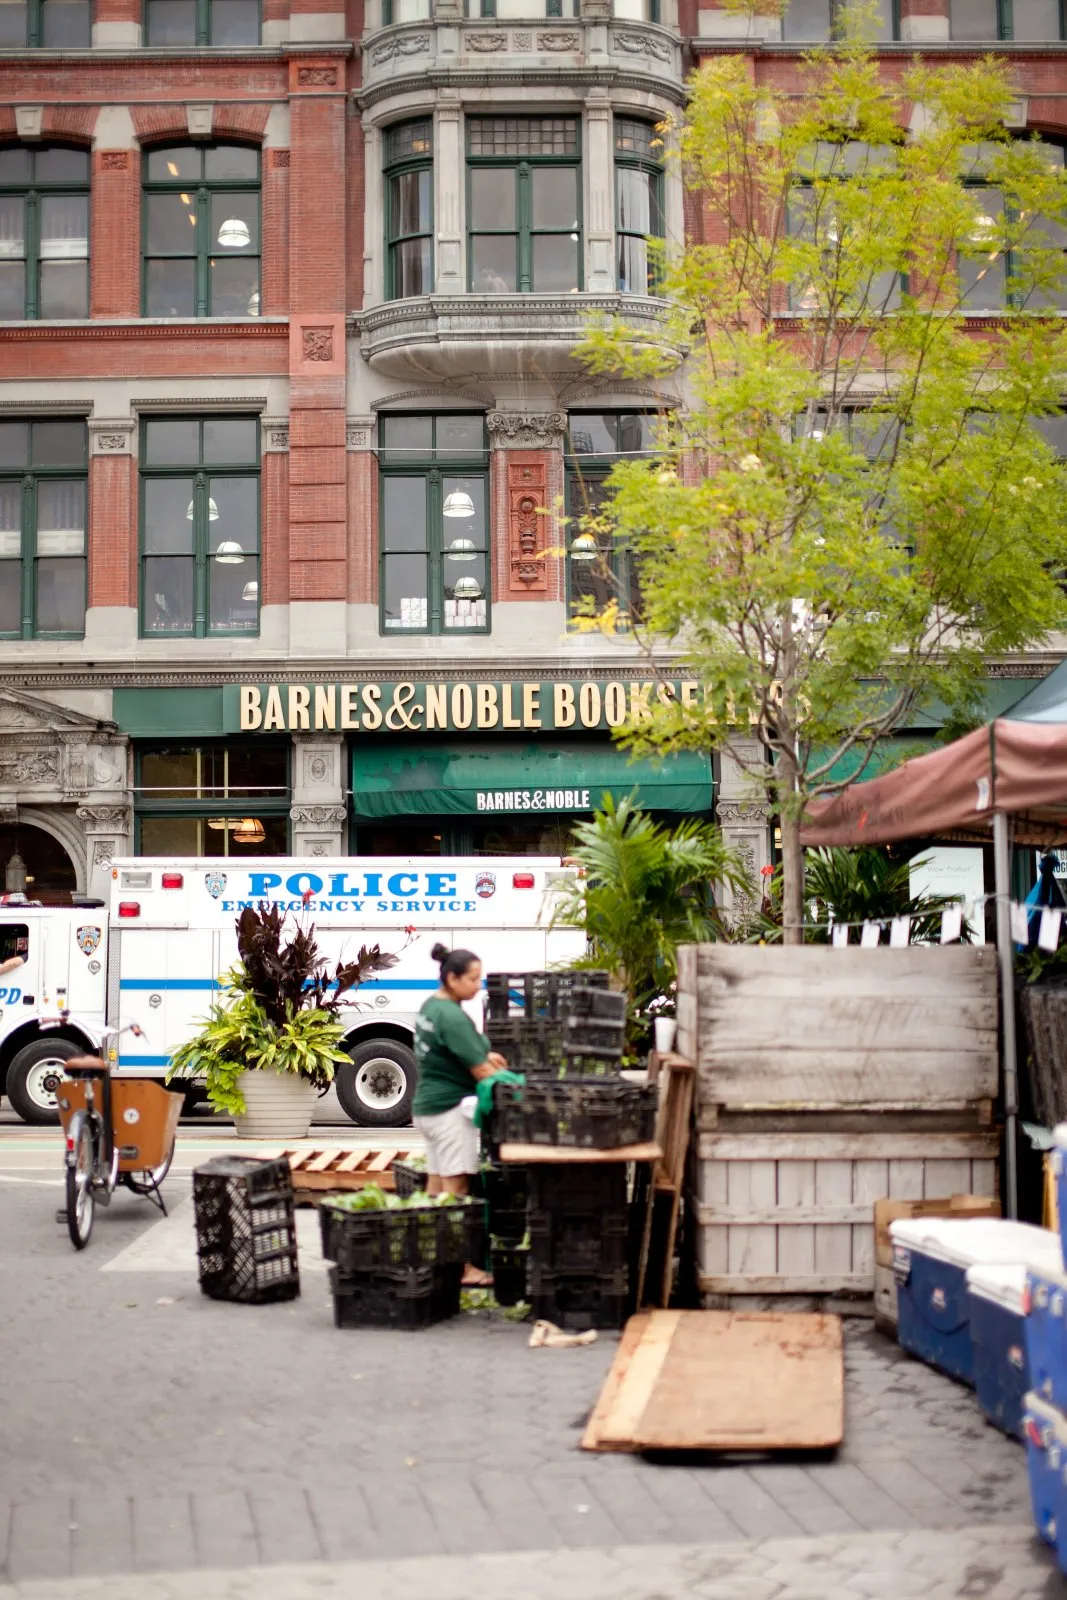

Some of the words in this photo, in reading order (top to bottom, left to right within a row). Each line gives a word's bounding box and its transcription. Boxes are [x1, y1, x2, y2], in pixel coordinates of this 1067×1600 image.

[477, 790, 590, 810] BARNES&NOBLE
[248, 873, 457, 897] POLICE
[221, 900, 365, 912] EMERGENCY
[377, 900, 477, 912] SERVICE
